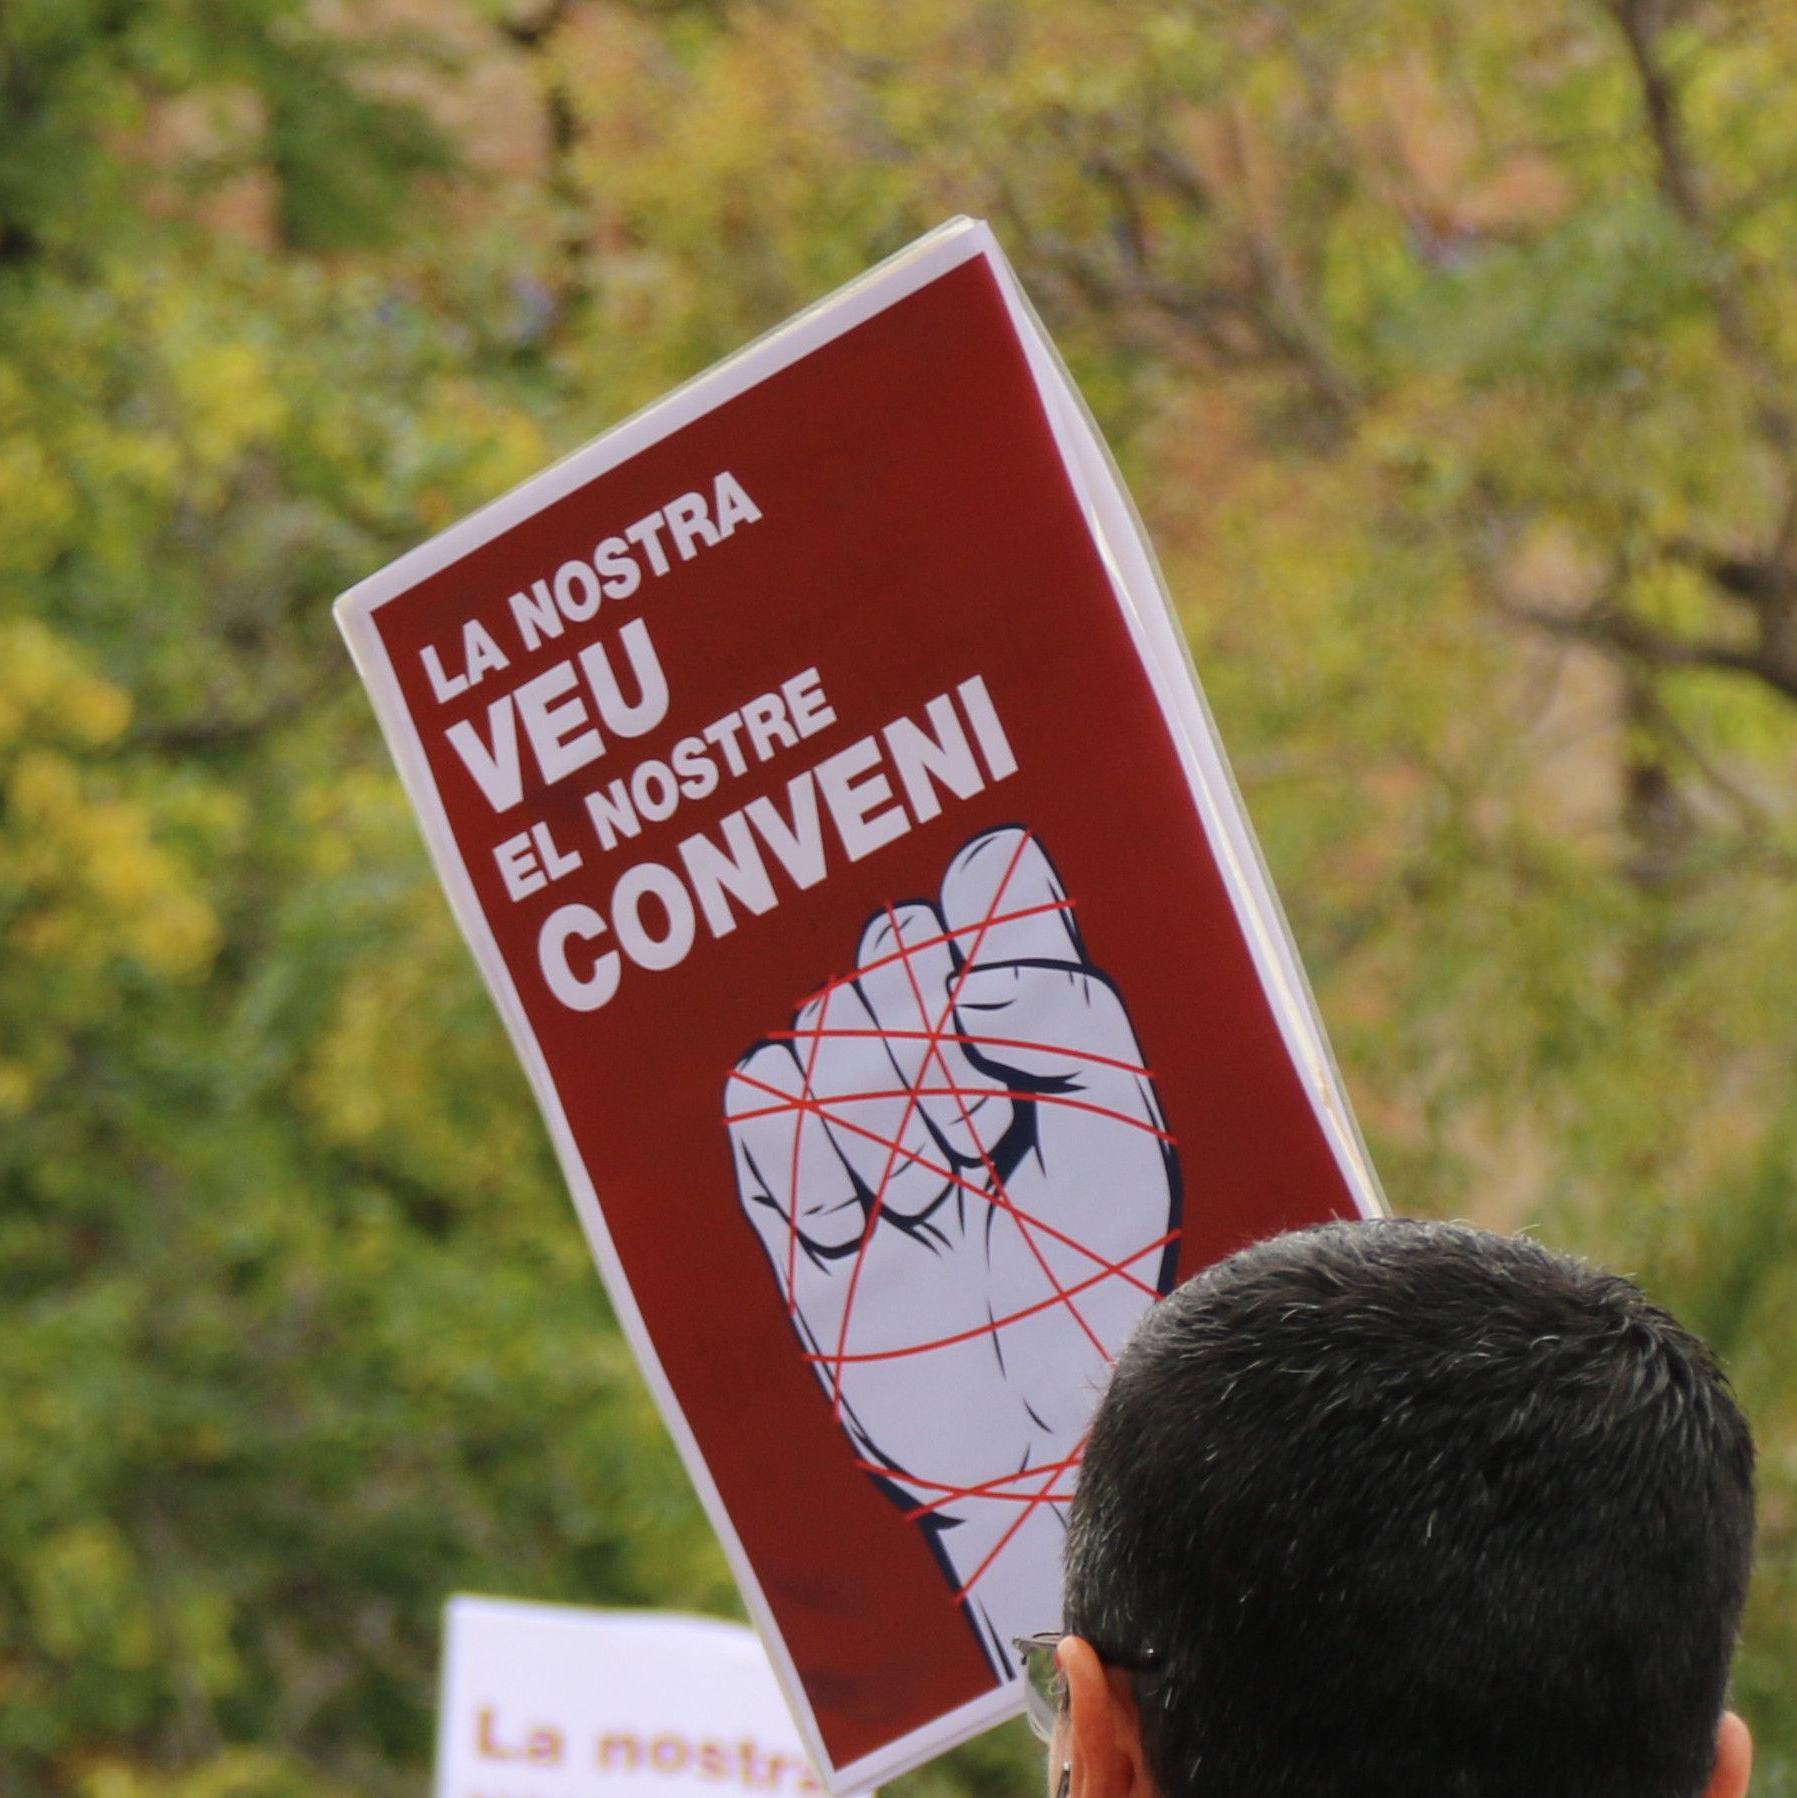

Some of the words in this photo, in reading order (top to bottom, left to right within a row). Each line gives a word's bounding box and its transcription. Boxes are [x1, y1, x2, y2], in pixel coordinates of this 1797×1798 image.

[420, 619, 509, 704] LA
[508, 472, 762, 652] NOSTRA
[445, 618, 668, 812] VEU
[492, 821, 583, 902] EL
[584, 668, 836, 851] NOSTRE
[538, 675, 1017, 1012] CONVENI
[473, 1703, 566, 1767] La
